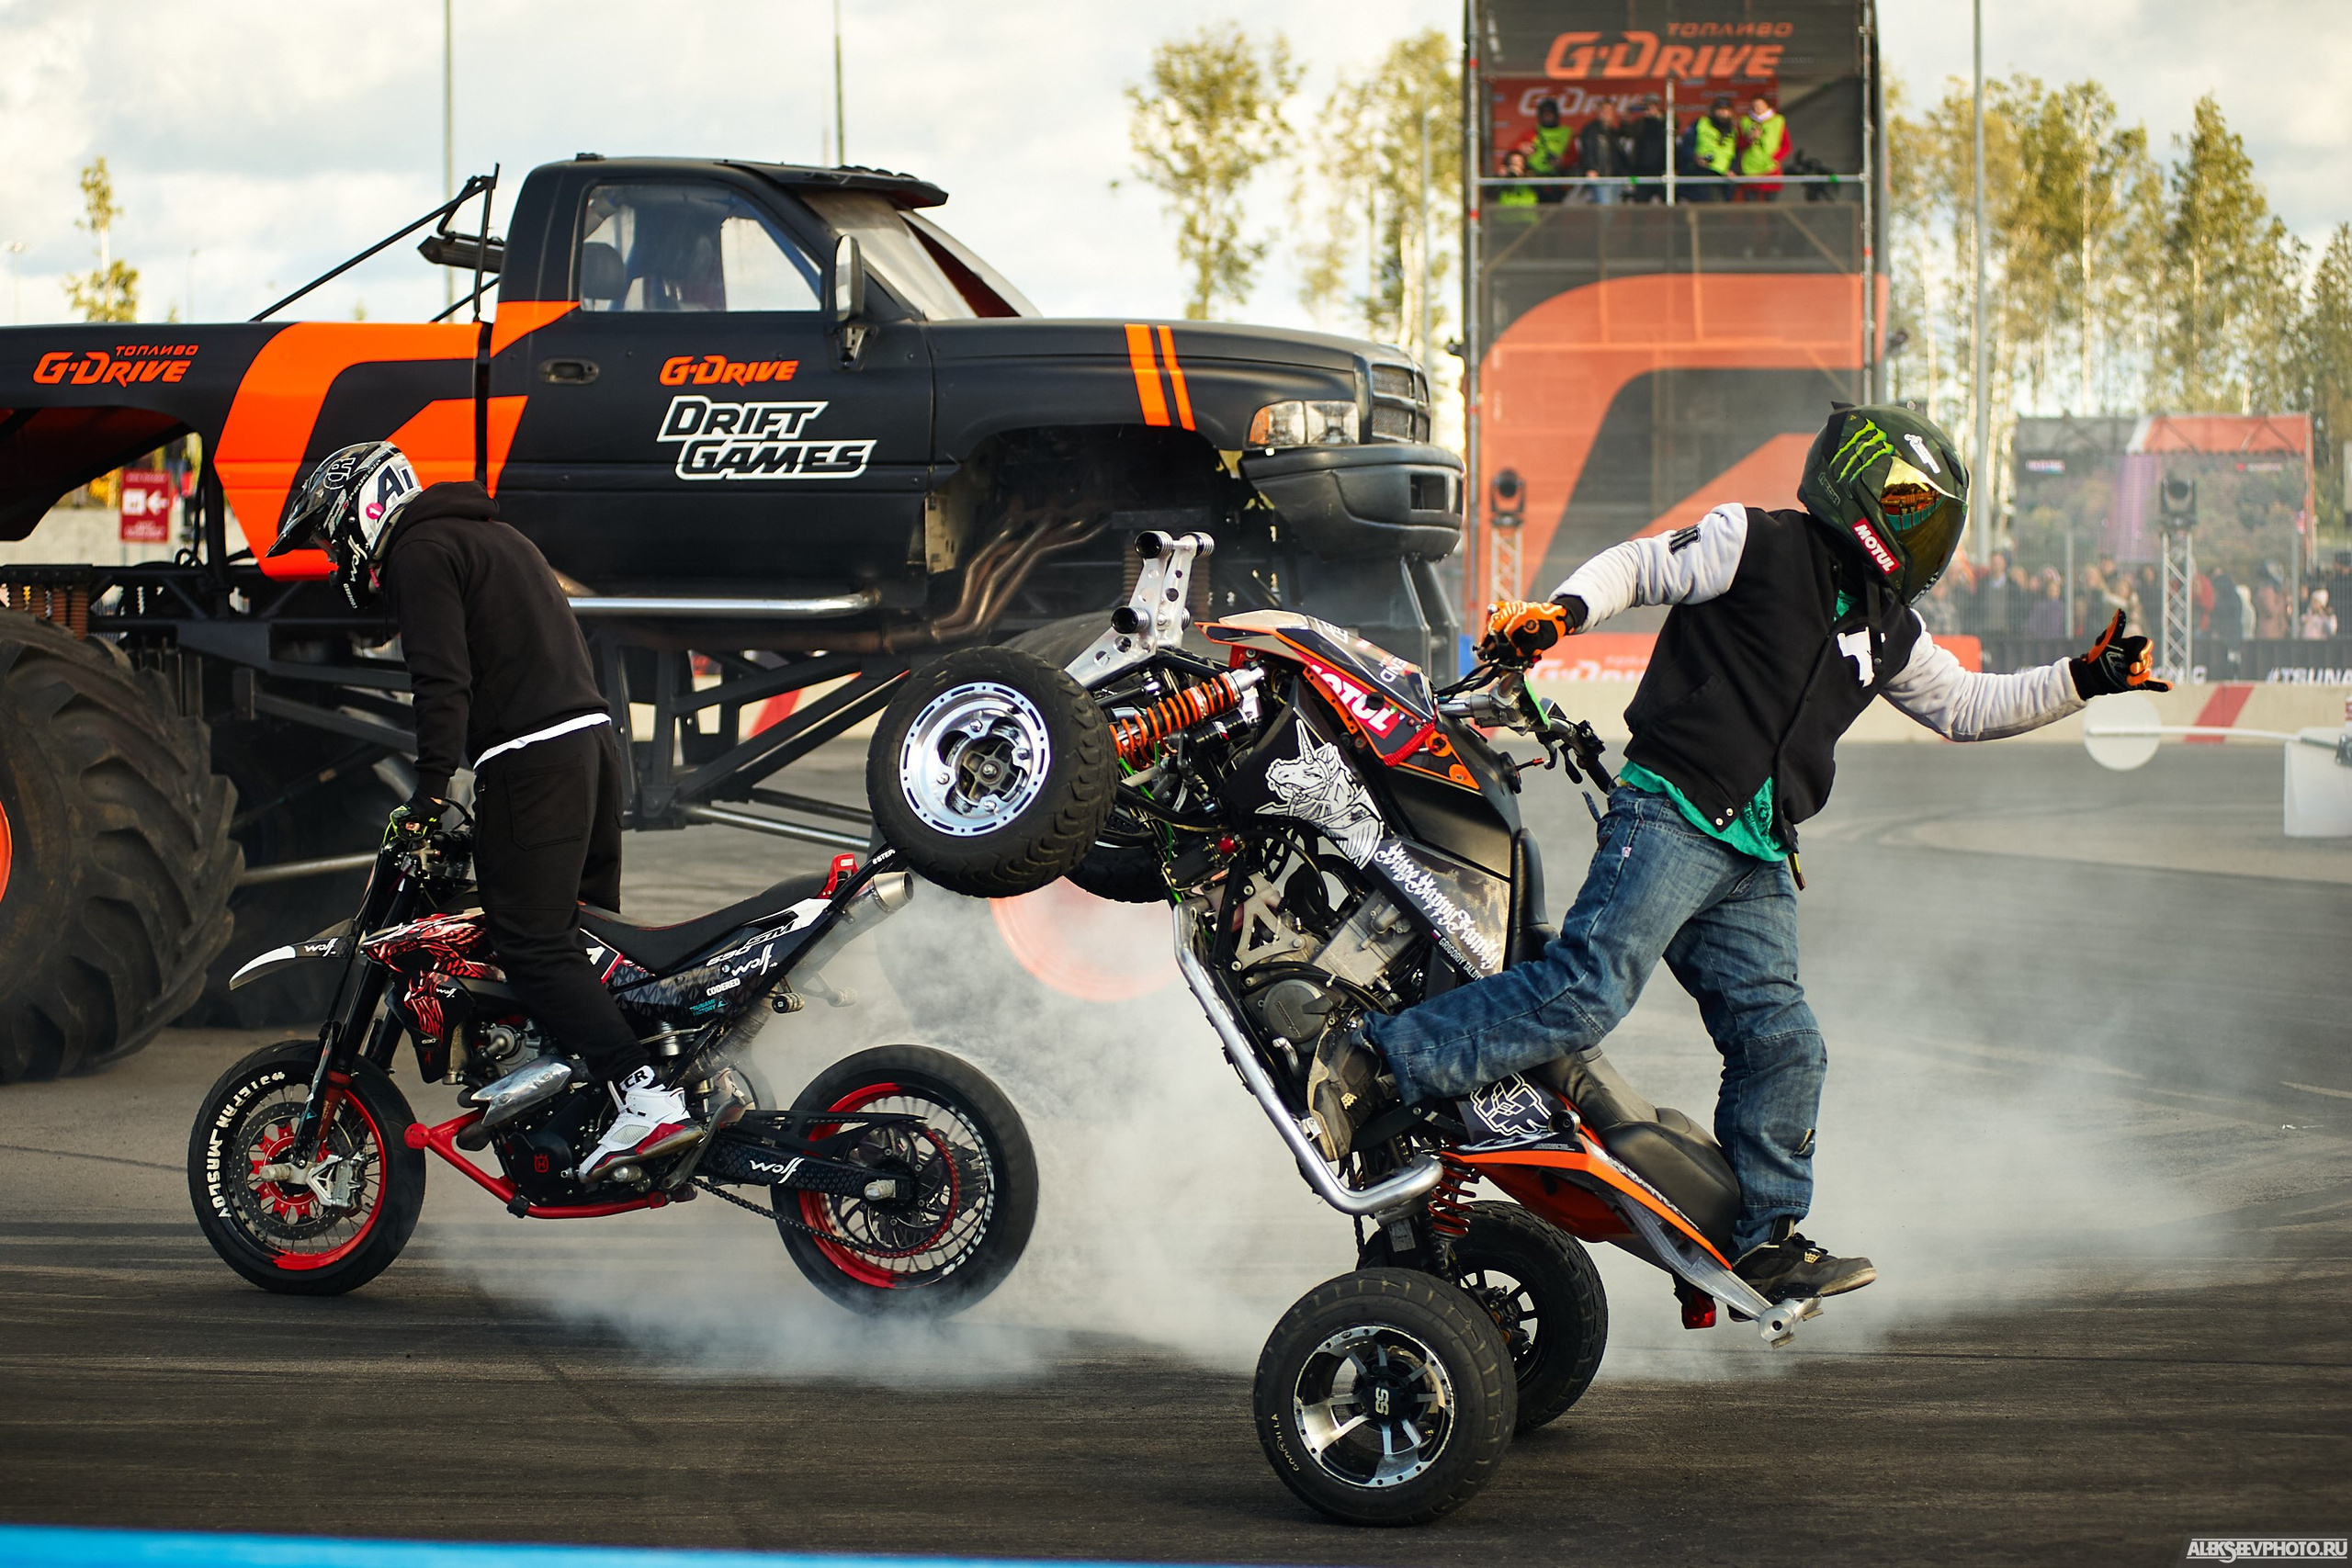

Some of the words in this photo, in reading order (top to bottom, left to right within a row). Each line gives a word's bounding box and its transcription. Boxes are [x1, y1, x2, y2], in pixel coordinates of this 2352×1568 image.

[1666, 21, 1794, 39] ТОПЛИВО
[115, 344, 199, 357] ТОПЛИВО
[658, 395, 827, 442] DRIFT
[676, 440, 876, 480] GAMES
[1854, 524, 1894, 572] MOTUL
[1311, 664, 1389, 732] OTUL
[1438, 937, 1464, 964] GRIGORIY
[1462, 961, 1486, 981] TALDY
[706, 977, 741, 997] CODERED
[623, 1069, 649, 1089] CR
[749, 1156, 806, 1185] wolf
